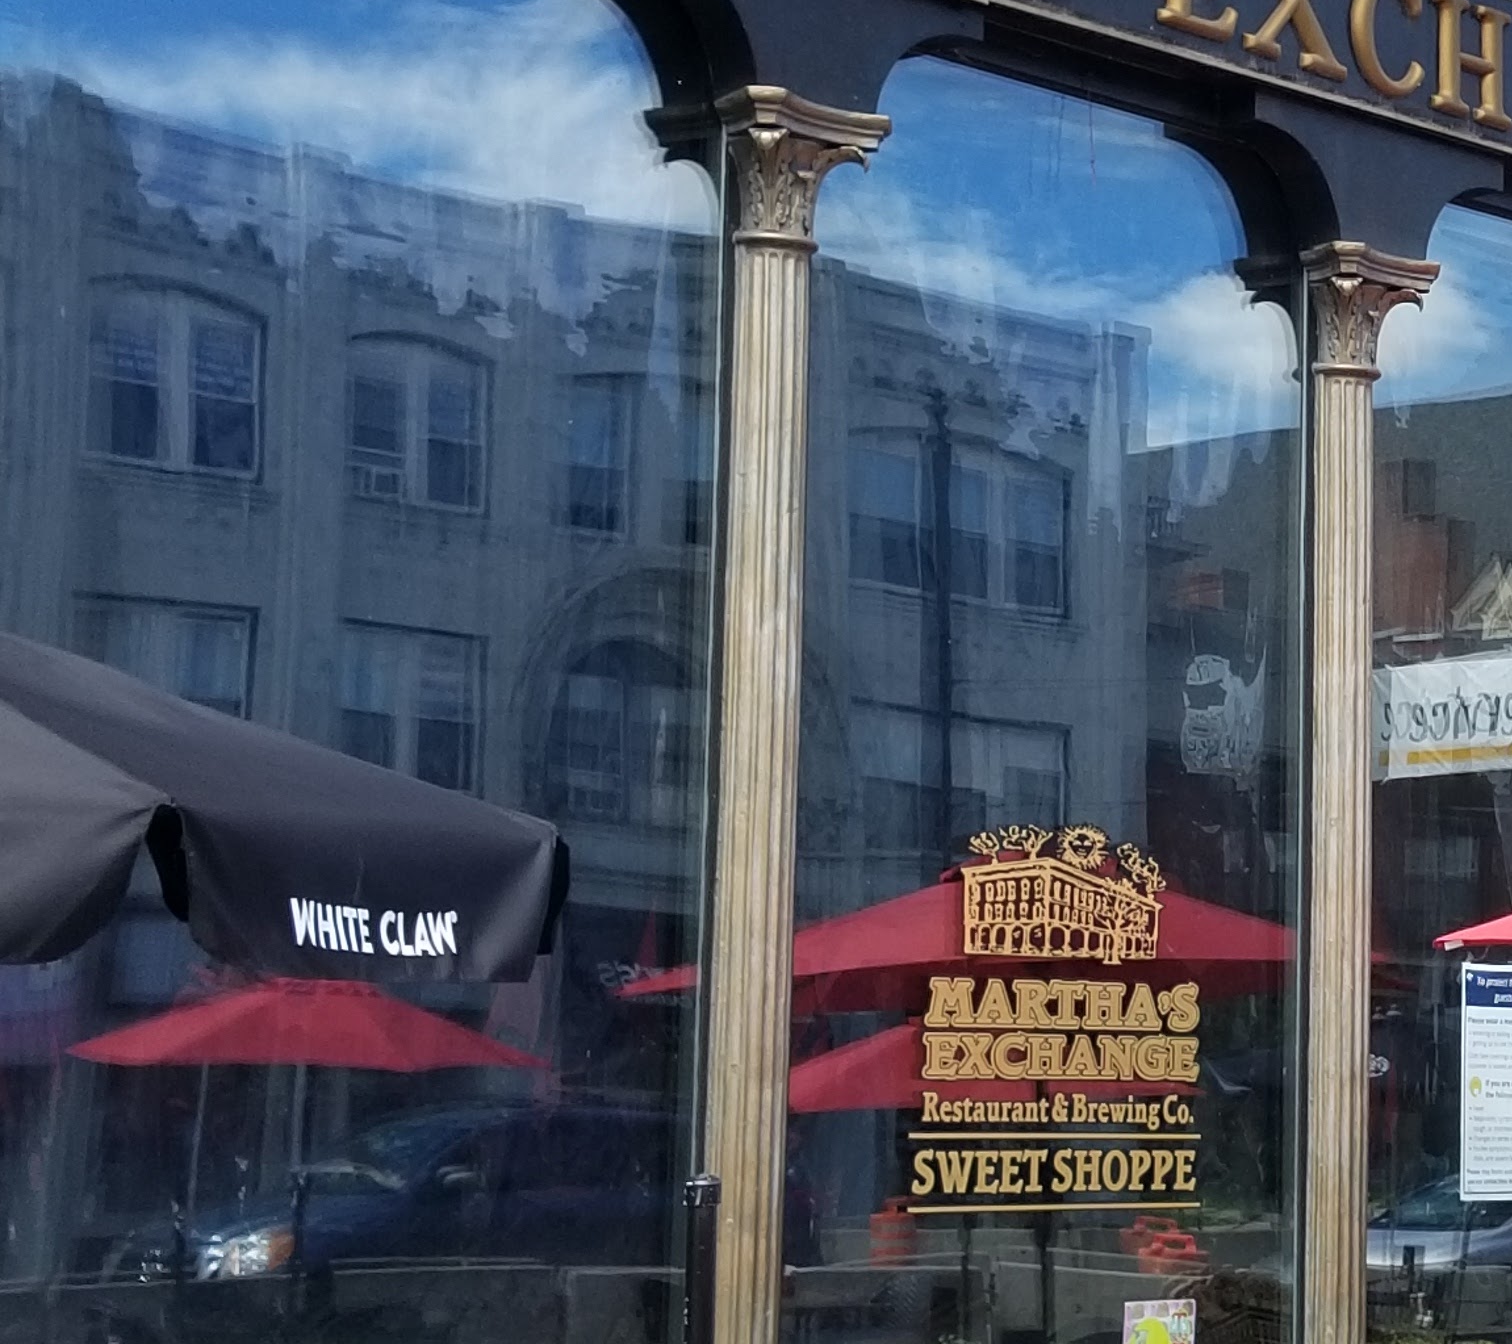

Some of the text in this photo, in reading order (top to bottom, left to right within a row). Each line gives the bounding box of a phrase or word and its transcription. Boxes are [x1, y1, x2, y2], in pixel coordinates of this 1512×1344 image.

[290, 897, 374, 955] WHITE
[924, 976, 1200, 1032] MARTHA'S
[922, 1031, 1200, 1083] EXCHANGE
[921, 1090, 1195, 1132] Restaurant & Brewing Co.
[911, 1146, 1197, 1196] SWEET SHOPPE
